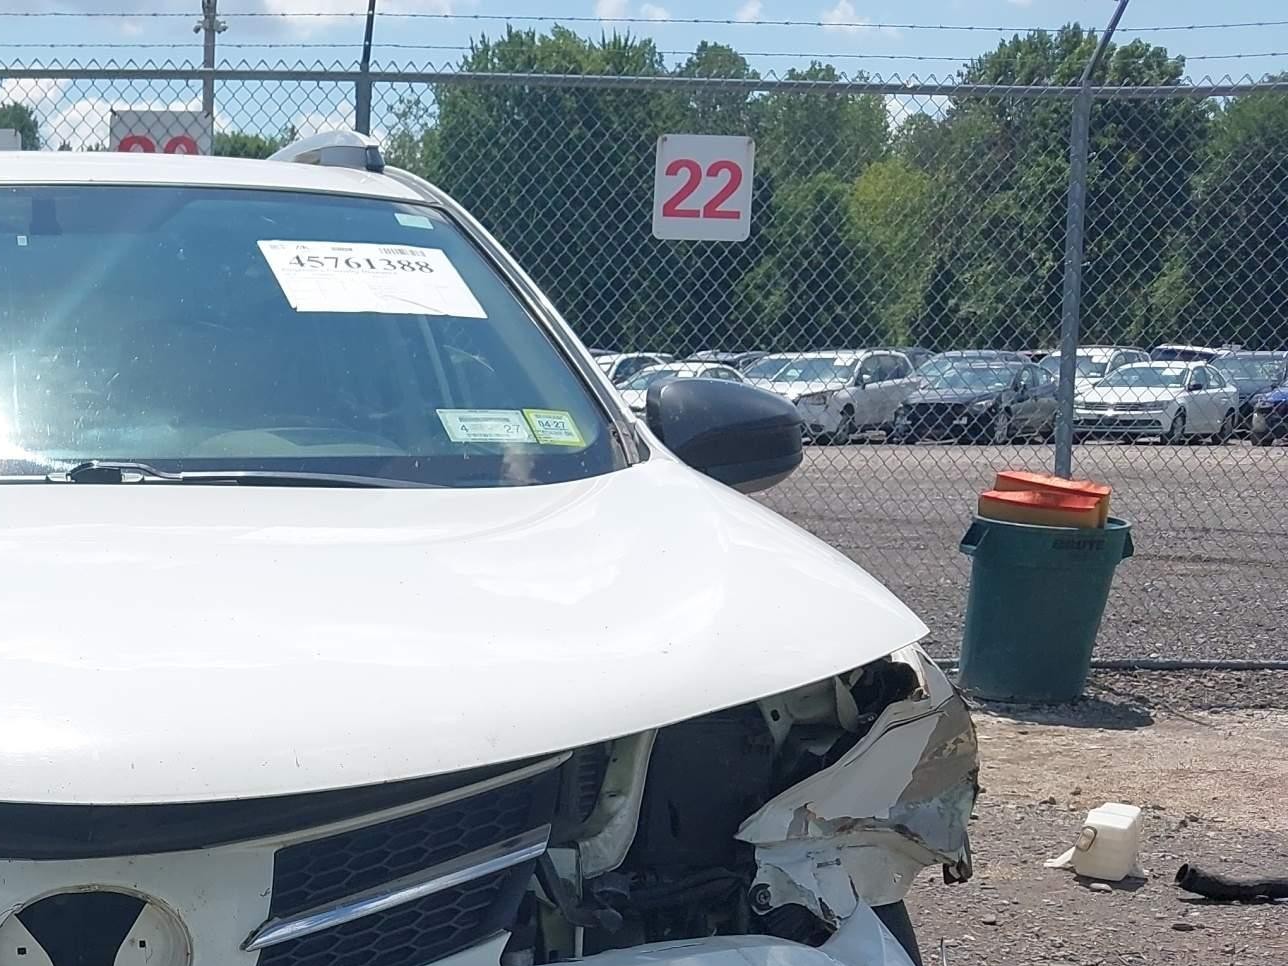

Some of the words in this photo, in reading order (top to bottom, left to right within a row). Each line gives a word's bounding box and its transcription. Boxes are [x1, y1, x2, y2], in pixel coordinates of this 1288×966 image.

[662, 159, 743, 219] 22
[289, 255, 434, 274] 45761388
[503, 424, 521, 433] 27
